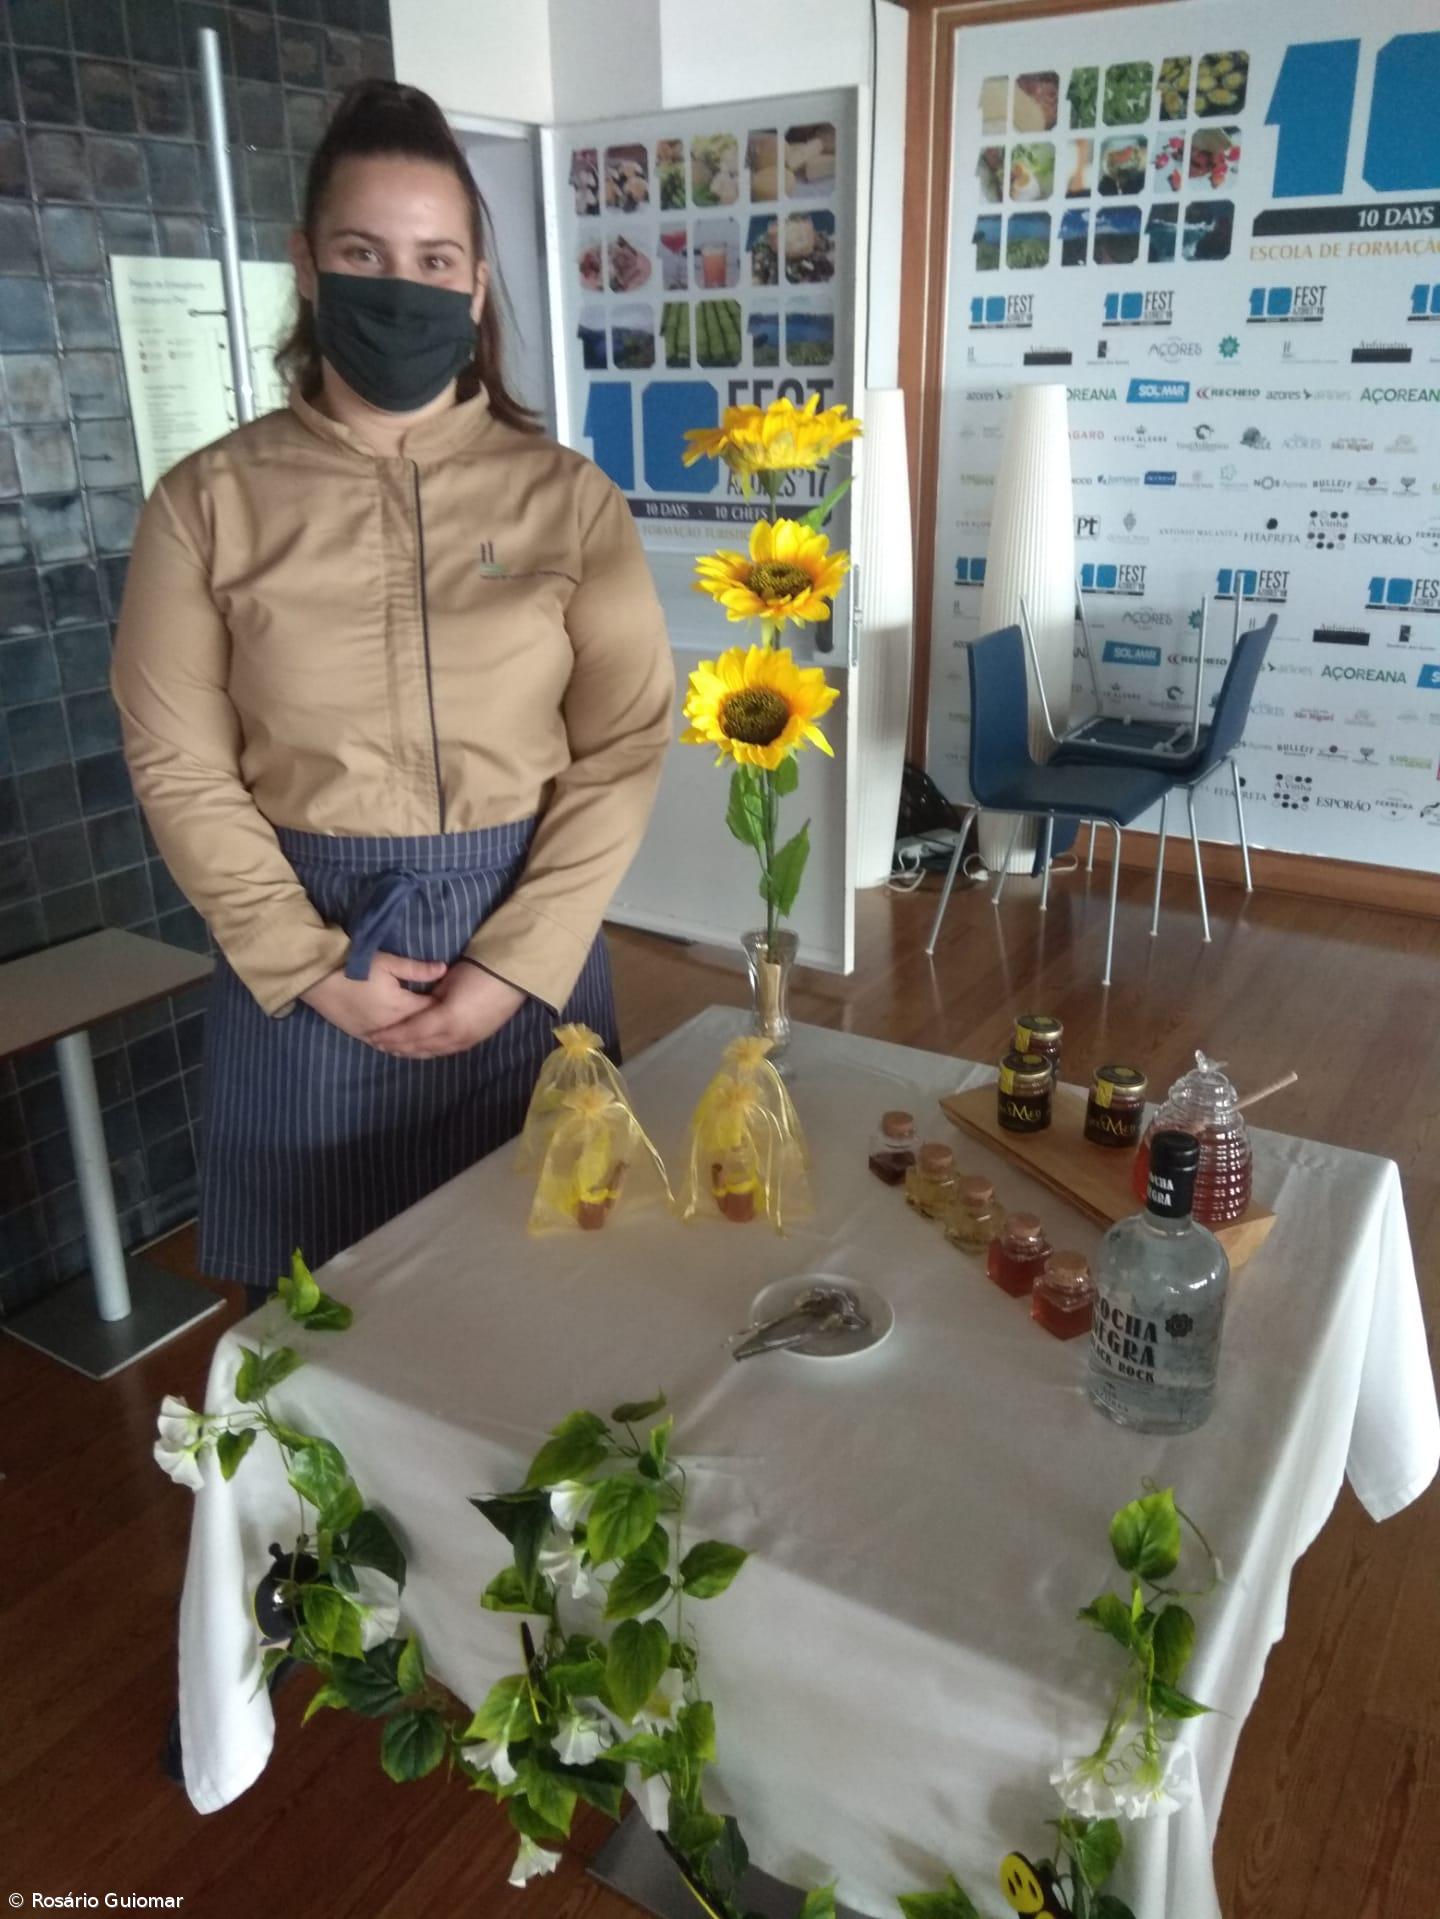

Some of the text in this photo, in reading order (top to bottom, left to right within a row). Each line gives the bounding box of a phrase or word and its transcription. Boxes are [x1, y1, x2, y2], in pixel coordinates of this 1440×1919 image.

[1358, 206, 1435, 228] 10 DAYS
[1250, 237, 1440, 262] ESCOLA DE FORMAÇÃ
[1007, 294, 1034, 315] FEST
[1144, 290, 1174, 311] FEST
[1294, 285, 1327, 306] FEST
[583, 381, 719, 493] 10
[1353, 531, 1413, 546] ESPORÃO
[1118, 564, 1147, 583] FEST
[1258, 570, 1290, 589] FEST
[1320, 664, 1407, 685] AÇOREANA
[1097, 1297, 1158, 1343] OCHA
[1093, 1318, 1156, 1368] EGRA
